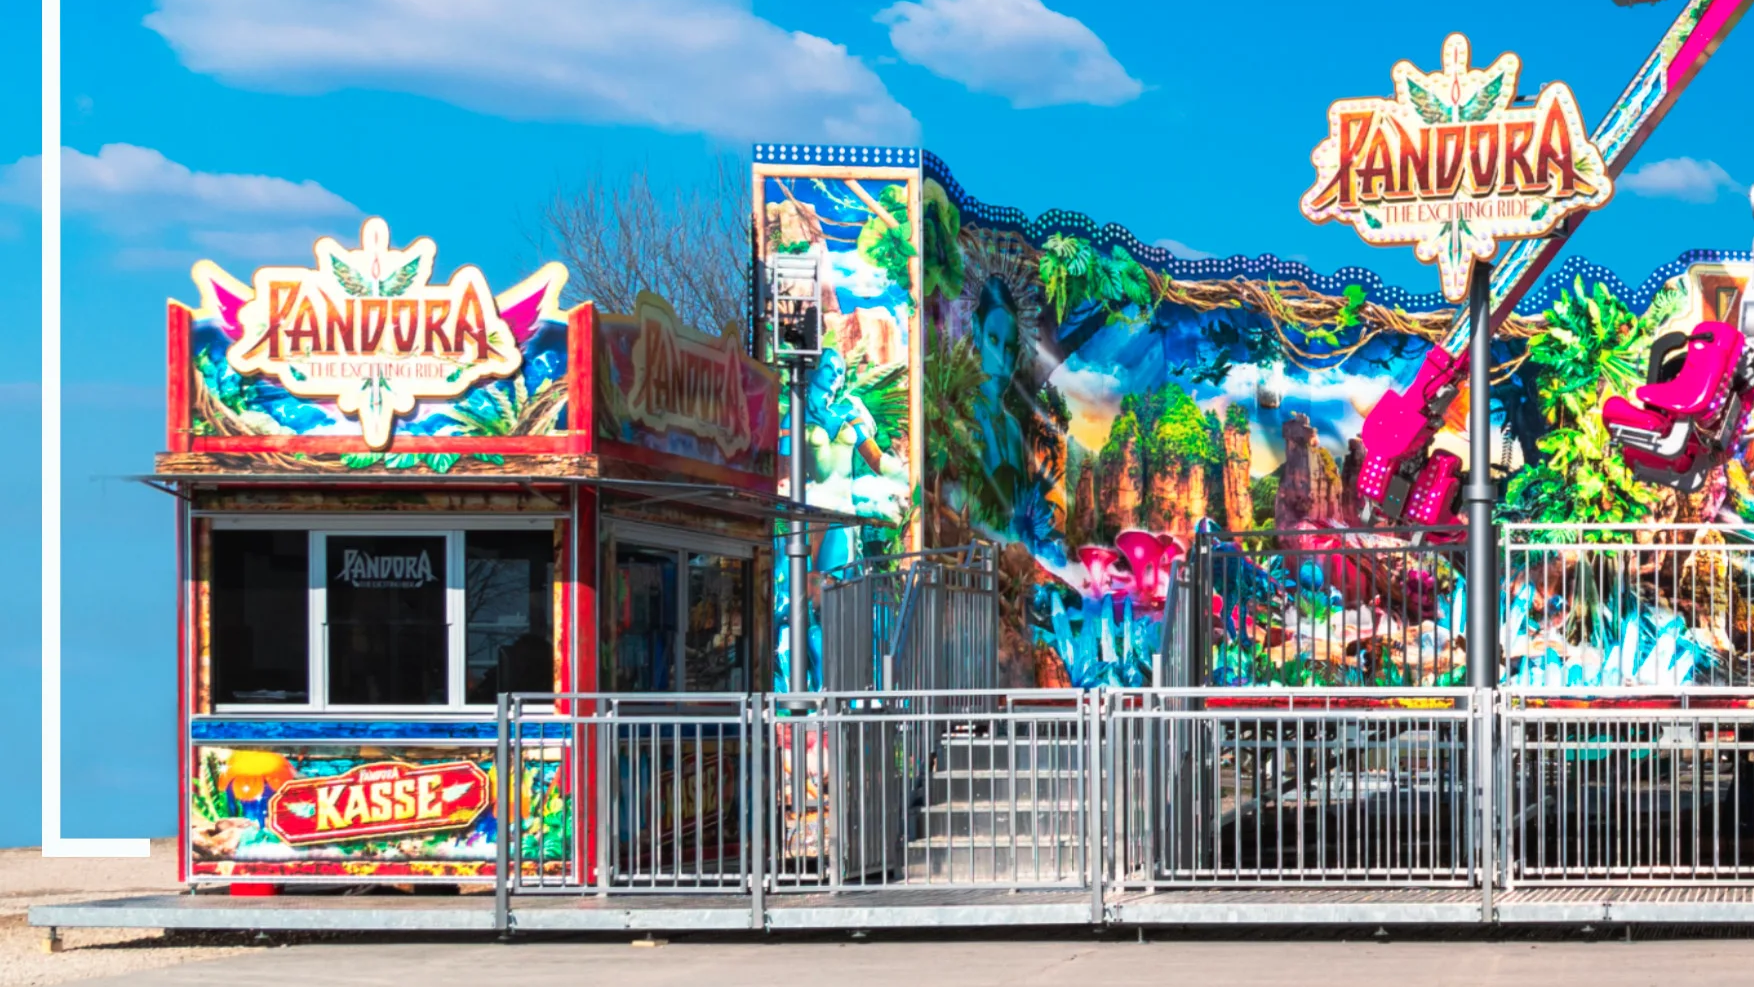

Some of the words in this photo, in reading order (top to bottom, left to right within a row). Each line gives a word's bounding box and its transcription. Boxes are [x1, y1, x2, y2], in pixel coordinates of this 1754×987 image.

[1310, 96, 1598, 210] PANDORA
[1382, 203, 1415, 223] THE
[1417, 200, 1493, 221] EXCITING
[1496, 197, 1534, 218] RIDE
[241, 280, 508, 362] PANDORA
[307, 362, 337, 378] THE
[340, 362, 412, 378] EXCITING
[415, 362, 447, 378] RIDE
[632, 318, 746, 438] PANDORA
[334, 549, 439, 582] PANDORA
[316, 774, 443, 831] KASSE
